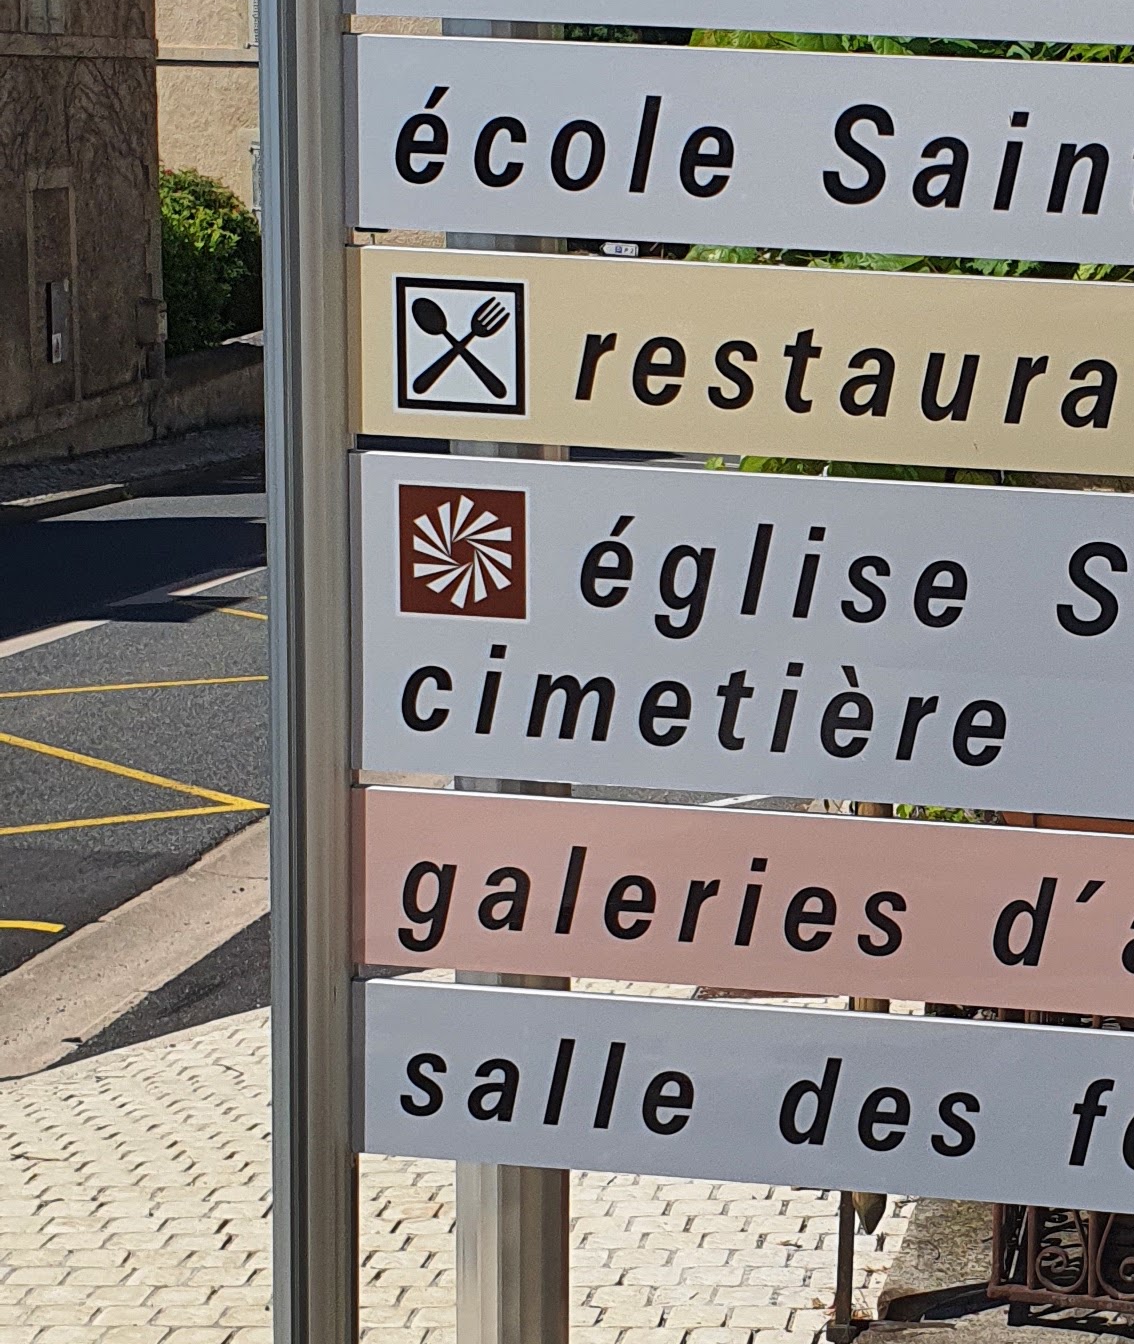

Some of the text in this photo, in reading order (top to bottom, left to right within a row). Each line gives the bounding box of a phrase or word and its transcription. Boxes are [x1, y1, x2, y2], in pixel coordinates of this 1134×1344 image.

[394, 85, 736, 198] école
[580, 515, 969, 640] église
[401, 643, 1008, 767] cimetière
[397, 845, 908, 953] galeries
[399, 1038, 696, 1136] salle
[778, 1057, 983, 1159] des
